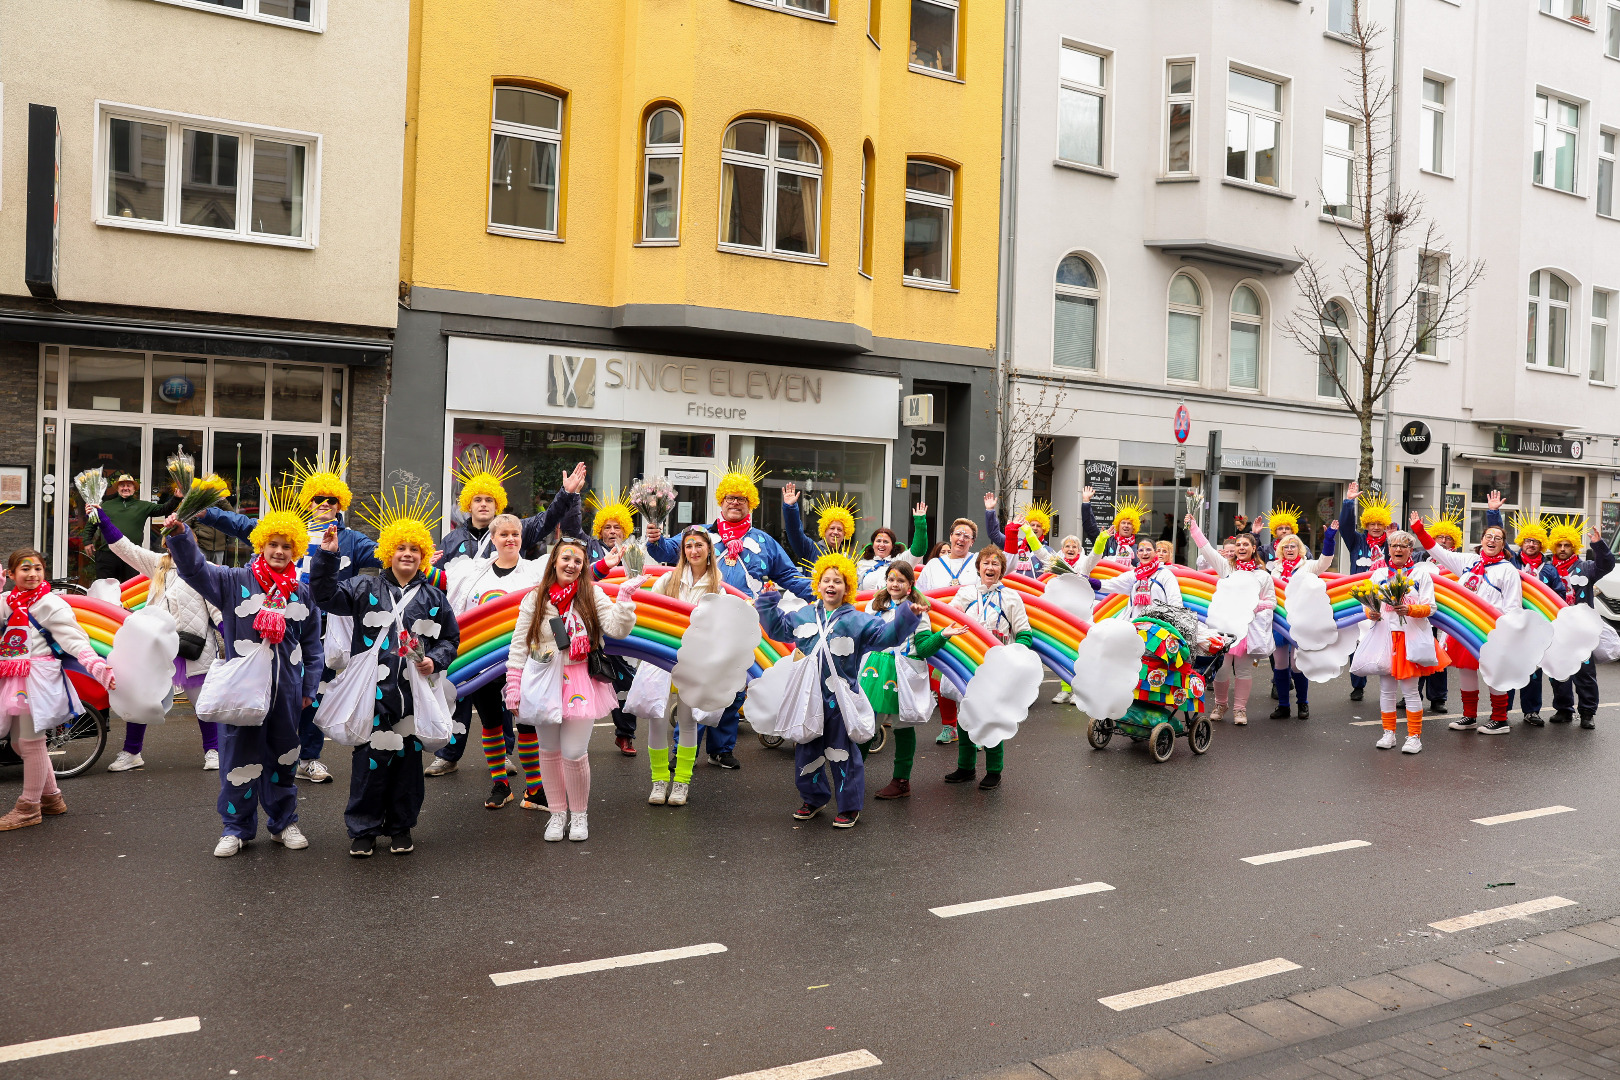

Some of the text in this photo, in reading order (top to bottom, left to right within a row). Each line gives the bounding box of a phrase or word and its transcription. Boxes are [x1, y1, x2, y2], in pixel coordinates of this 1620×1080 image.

[605, 359, 822, 404] SINCE ELEVEN
[687, 402, 747, 420] Friseure
[1401, 435, 1426, 443] GUINNESS
[1517, 437, 1563, 454] JAMES JOYCE
[1572, 446, 1580, 455] 13
